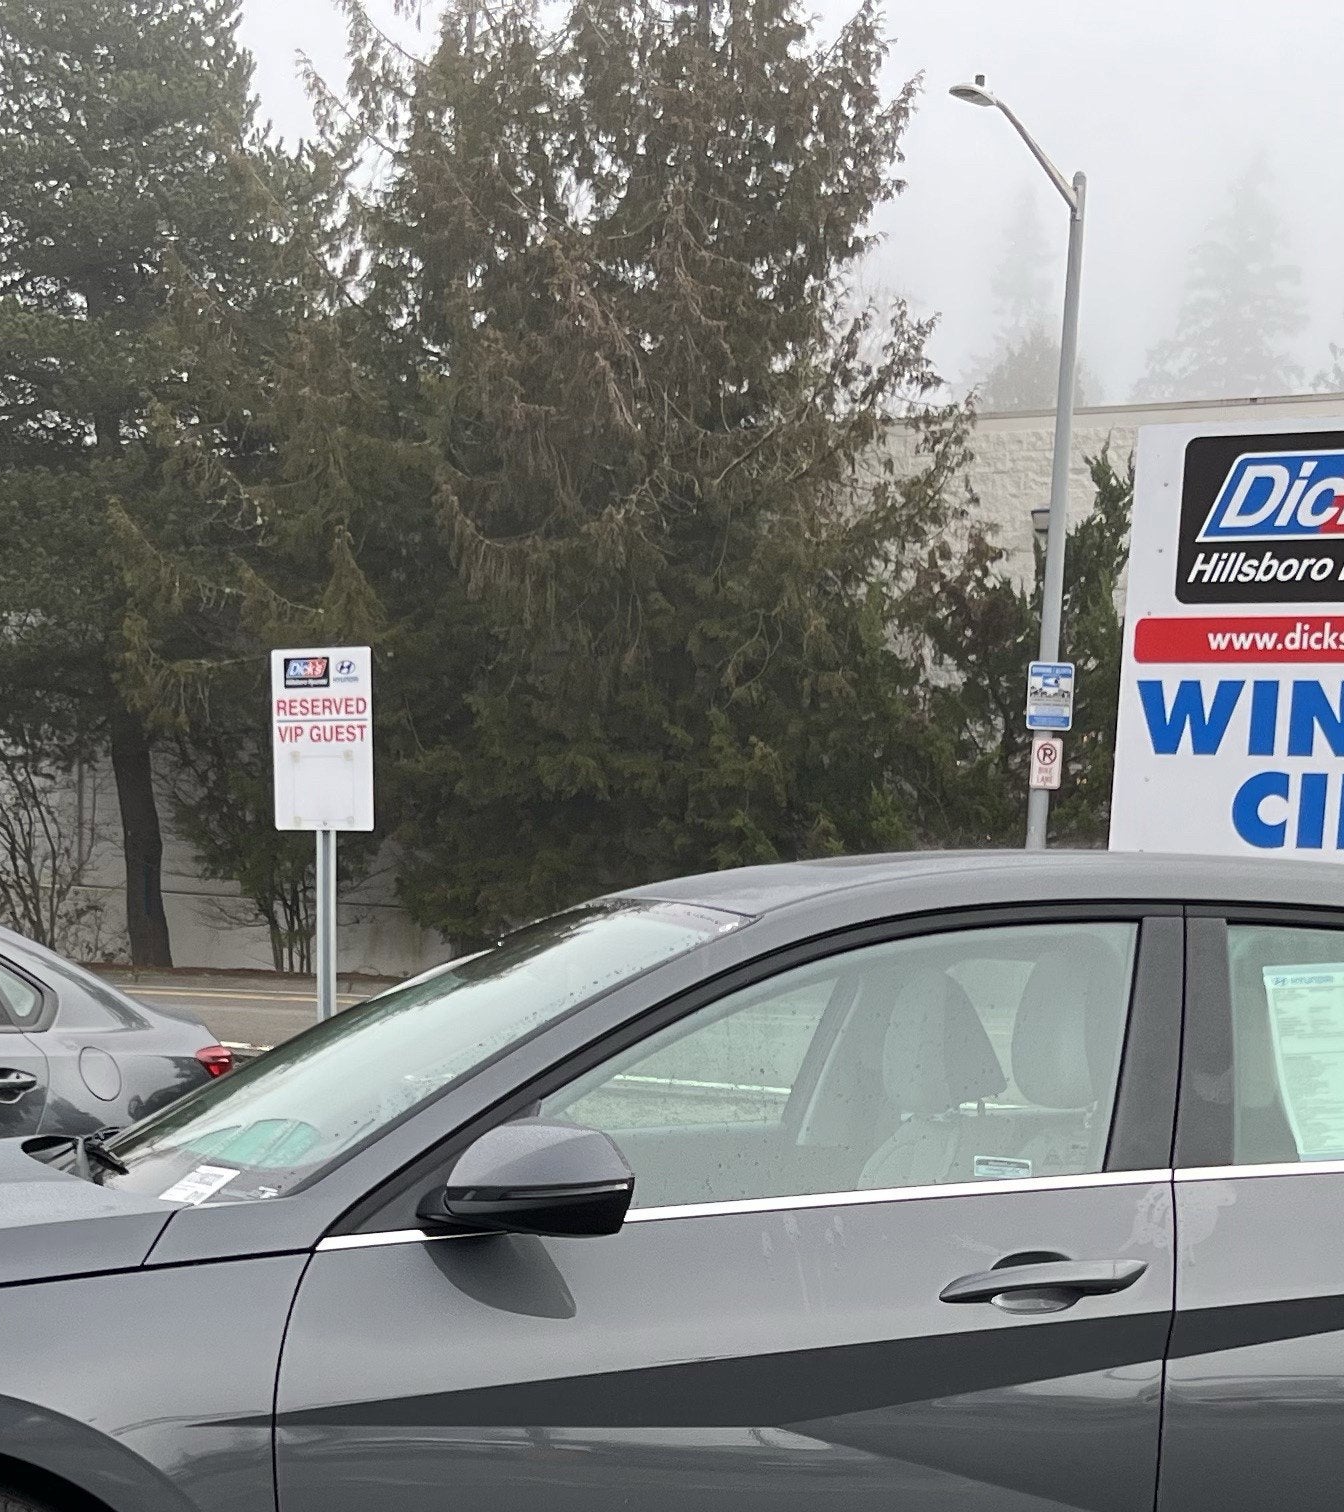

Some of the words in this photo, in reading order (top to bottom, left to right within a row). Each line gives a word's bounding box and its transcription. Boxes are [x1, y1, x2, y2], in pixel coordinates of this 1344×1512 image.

[1186, 551, 1335, 584] Hillsboro
[276, 697, 367, 717] RESERVED
[278, 725, 304, 744] VIP
[309, 724, 367, 743] GUEST
